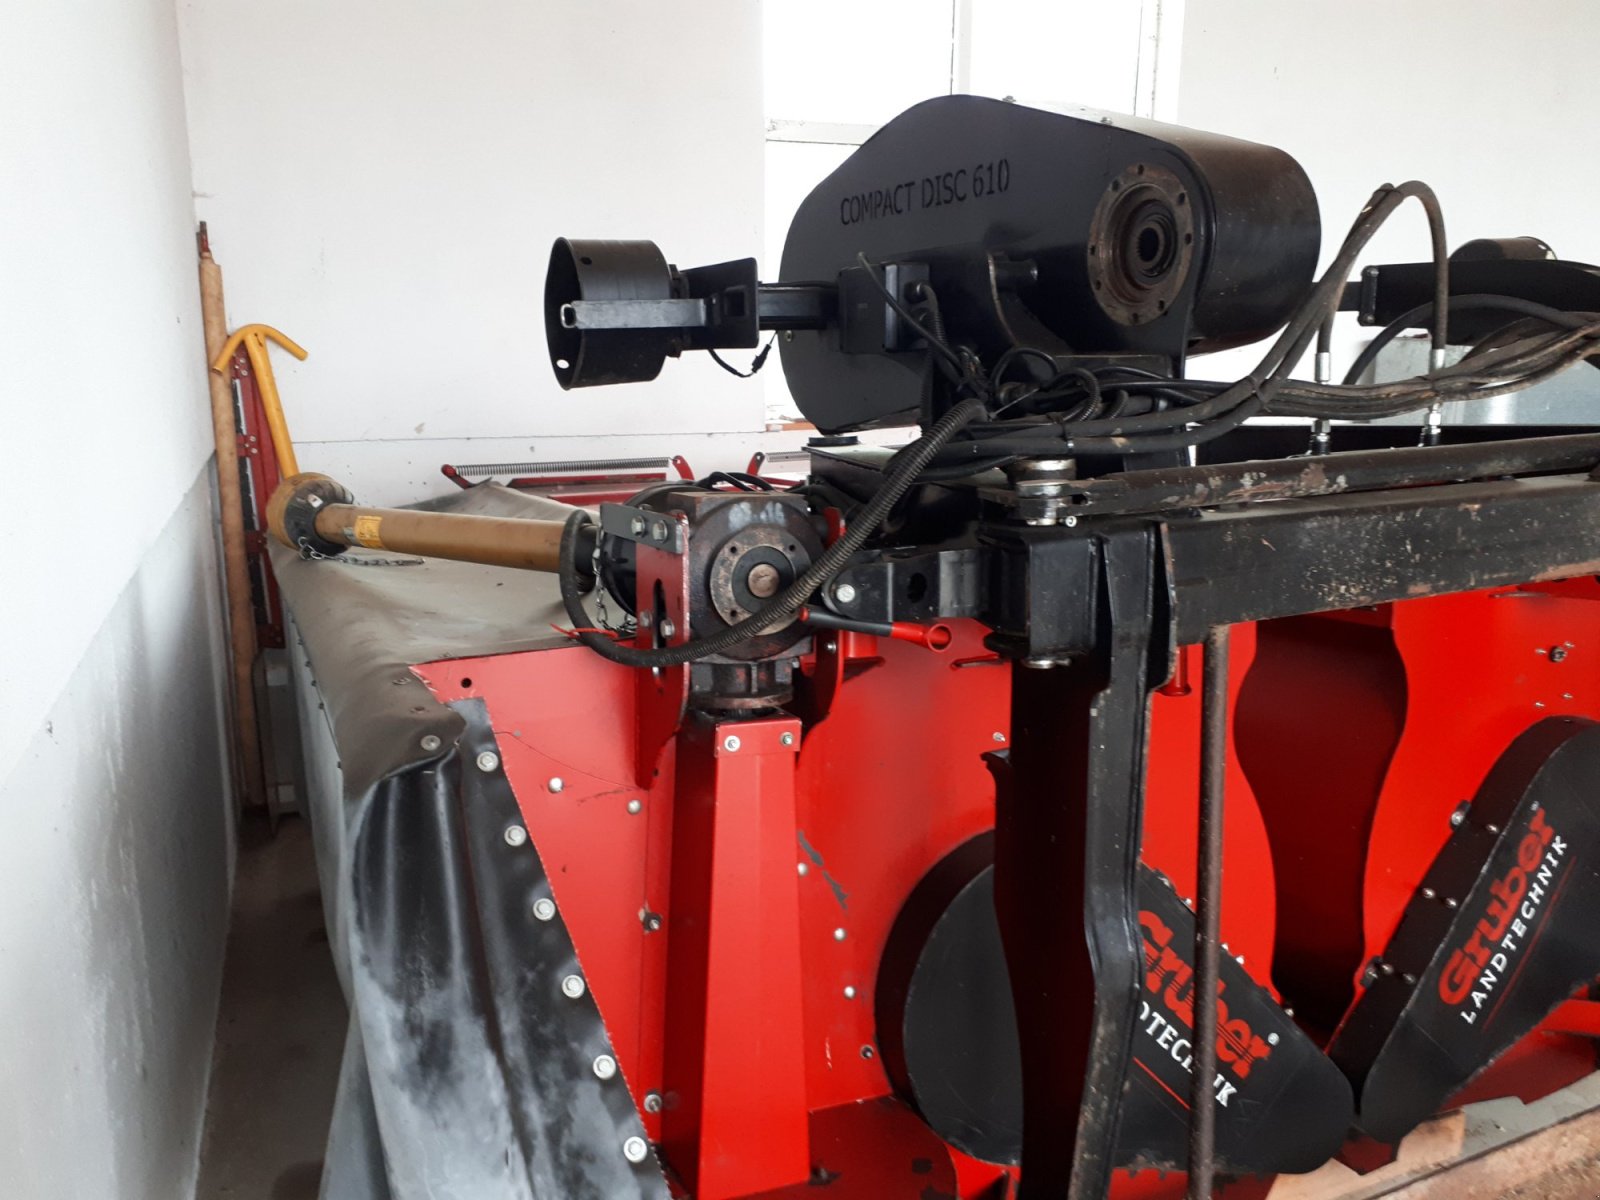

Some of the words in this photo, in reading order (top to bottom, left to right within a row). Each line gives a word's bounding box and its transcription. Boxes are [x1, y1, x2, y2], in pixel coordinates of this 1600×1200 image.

[841, 181, 915, 225] COMPACT
[921, 169, 967, 208] DISC
[972, 158, 1010, 198] 610
[1438, 807, 1554, 1005] Gruber
[1460, 835, 1568, 1025] LANDTECHNIK
